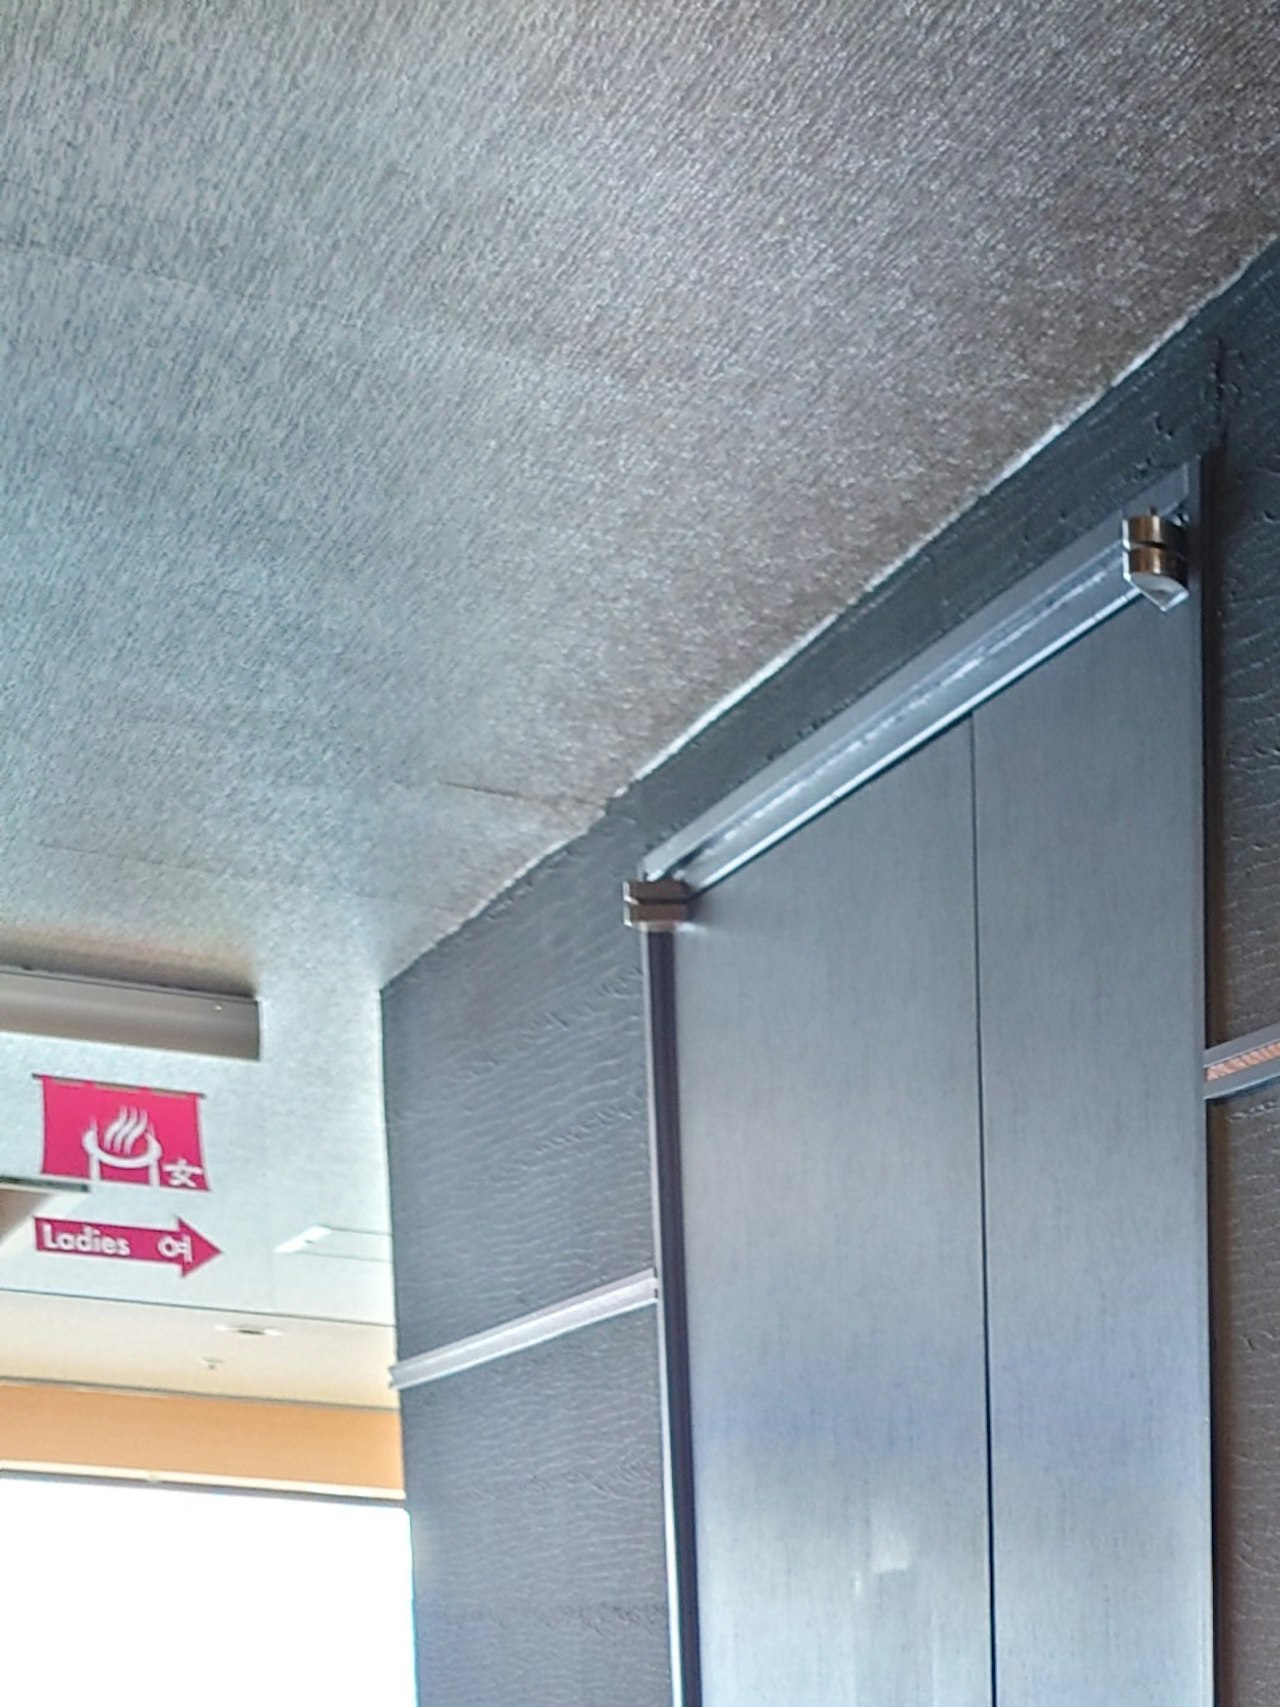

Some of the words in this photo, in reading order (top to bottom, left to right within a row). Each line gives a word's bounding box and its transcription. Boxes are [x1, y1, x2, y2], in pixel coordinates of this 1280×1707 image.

[162, 1158, 204, 1188] 女
[42, 1223, 131, 1256] Ladies
[157, 1235, 194, 1263] 여
